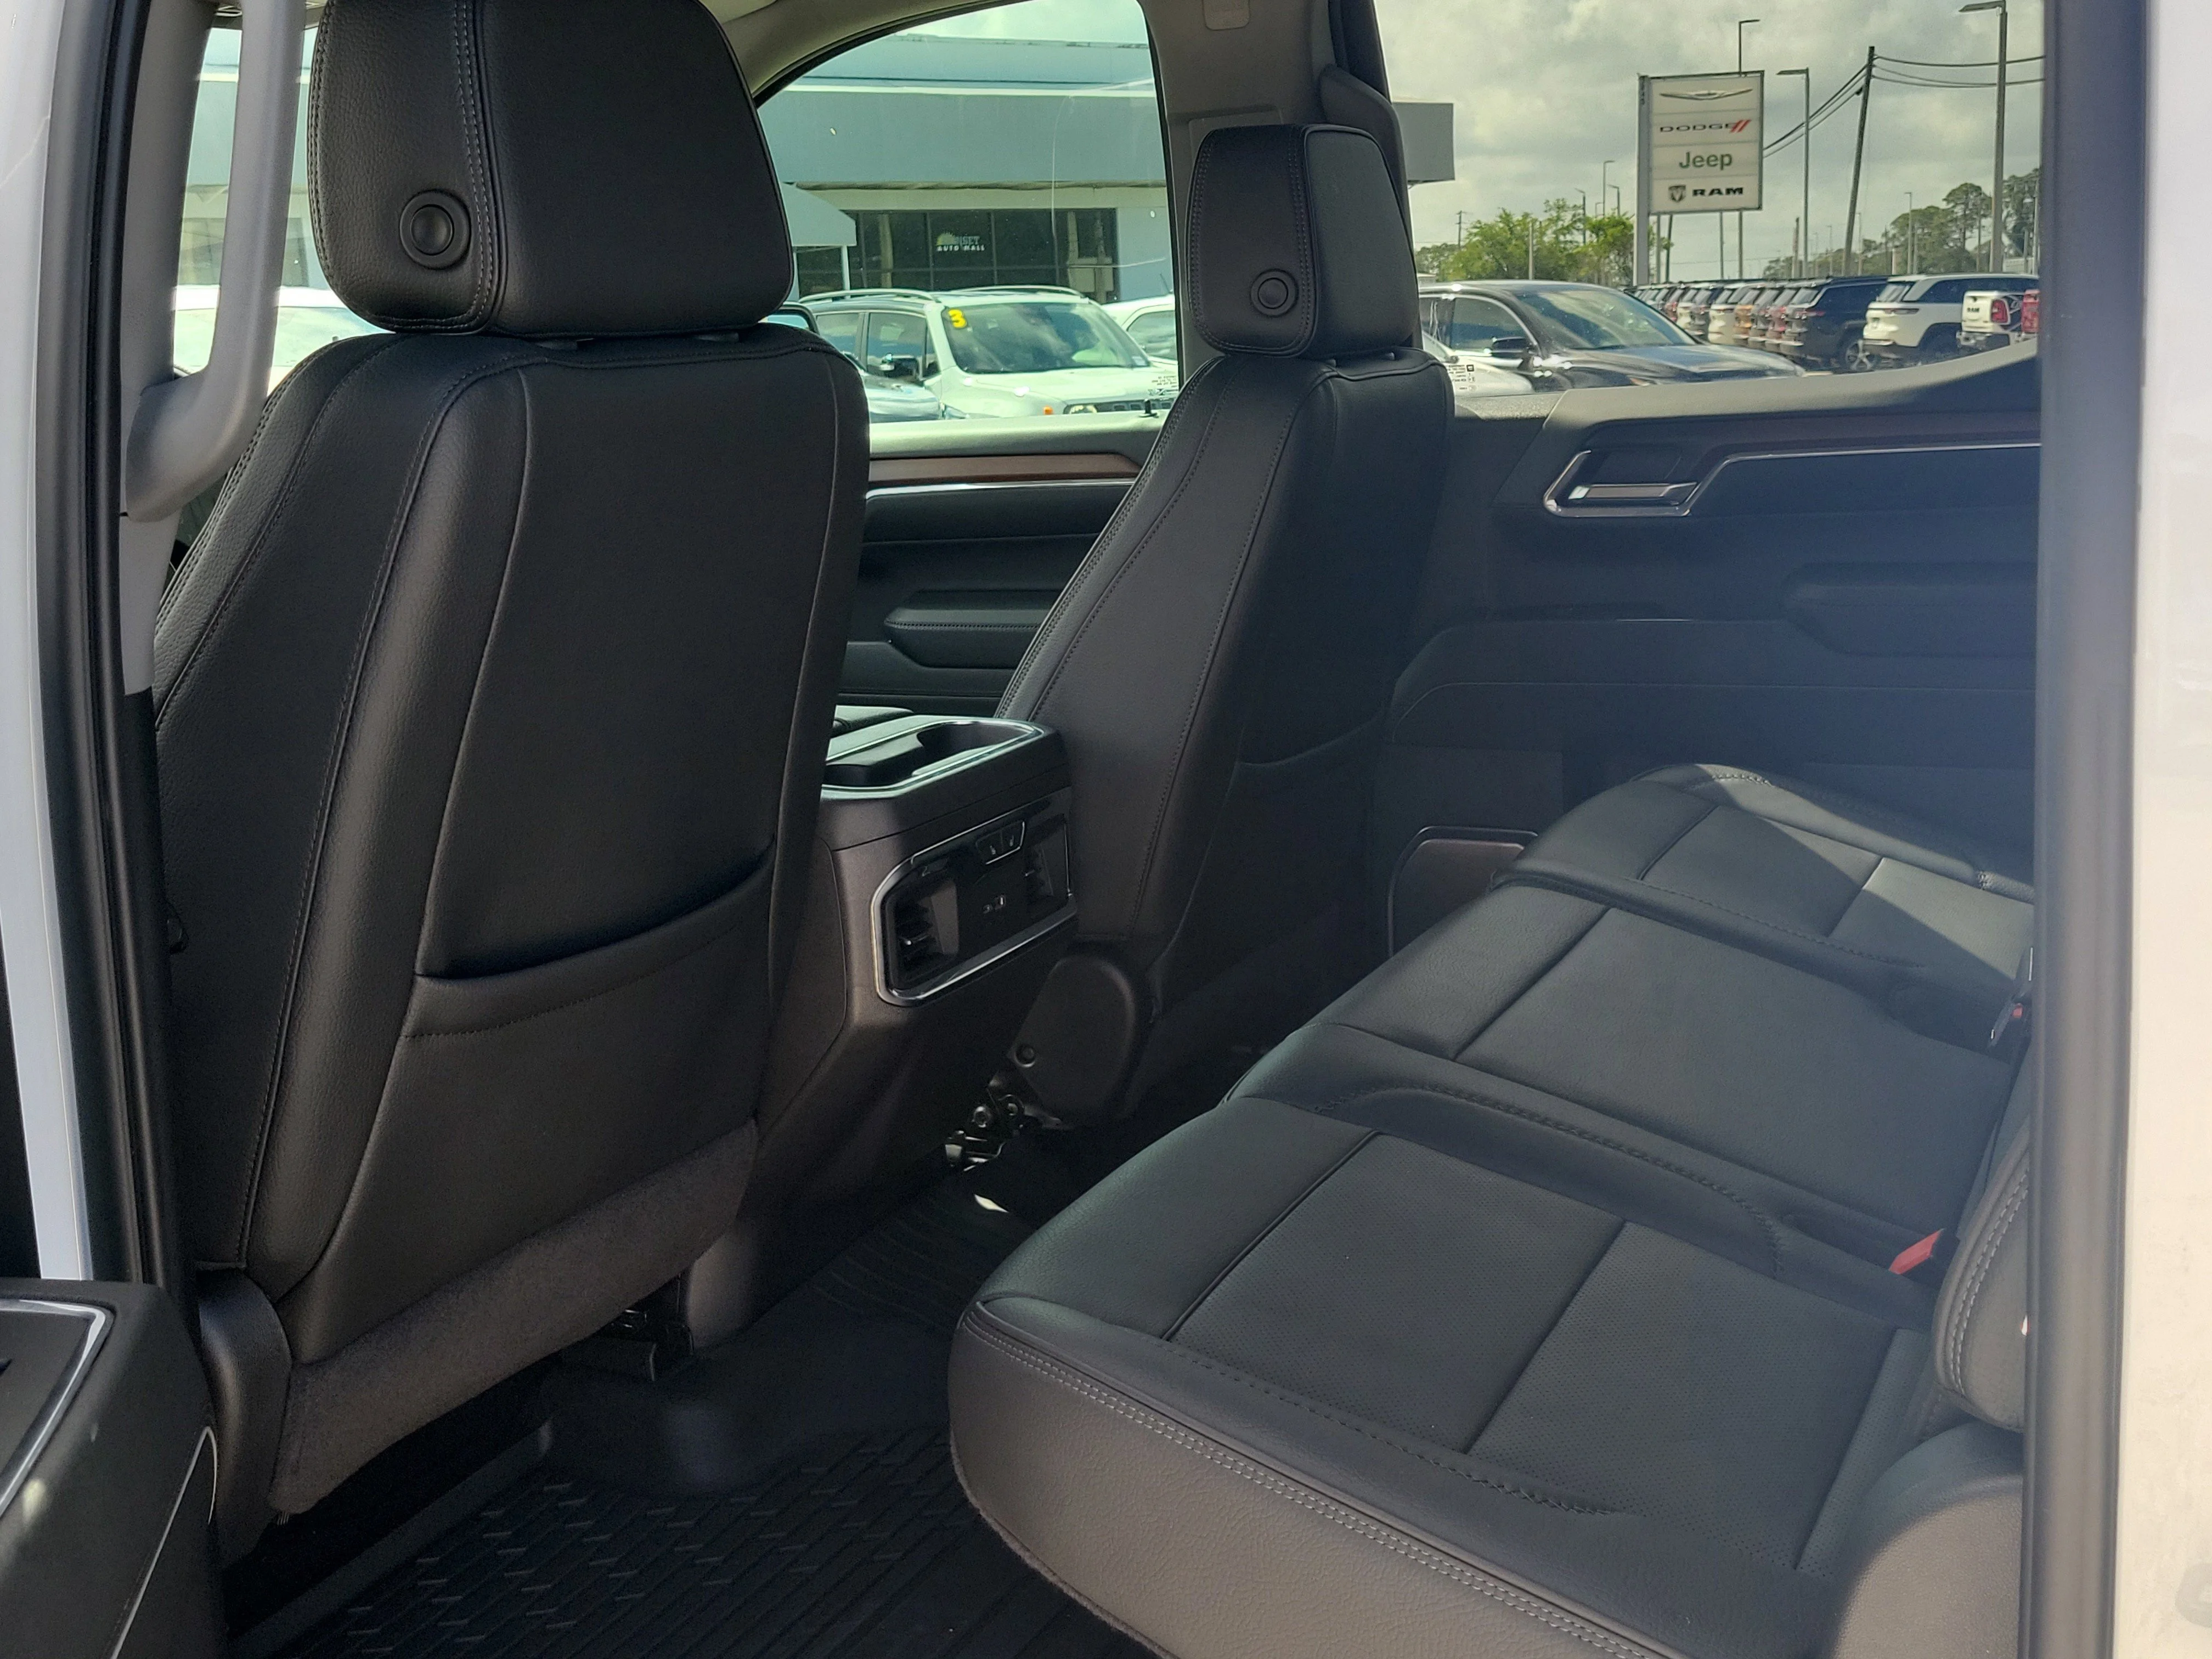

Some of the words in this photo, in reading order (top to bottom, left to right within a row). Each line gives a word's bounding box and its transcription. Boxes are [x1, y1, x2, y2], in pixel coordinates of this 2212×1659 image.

[1679, 151, 1733, 170] Jeep
[1692, 187, 1743, 196] RAM
[948, 308, 967, 329] 3
